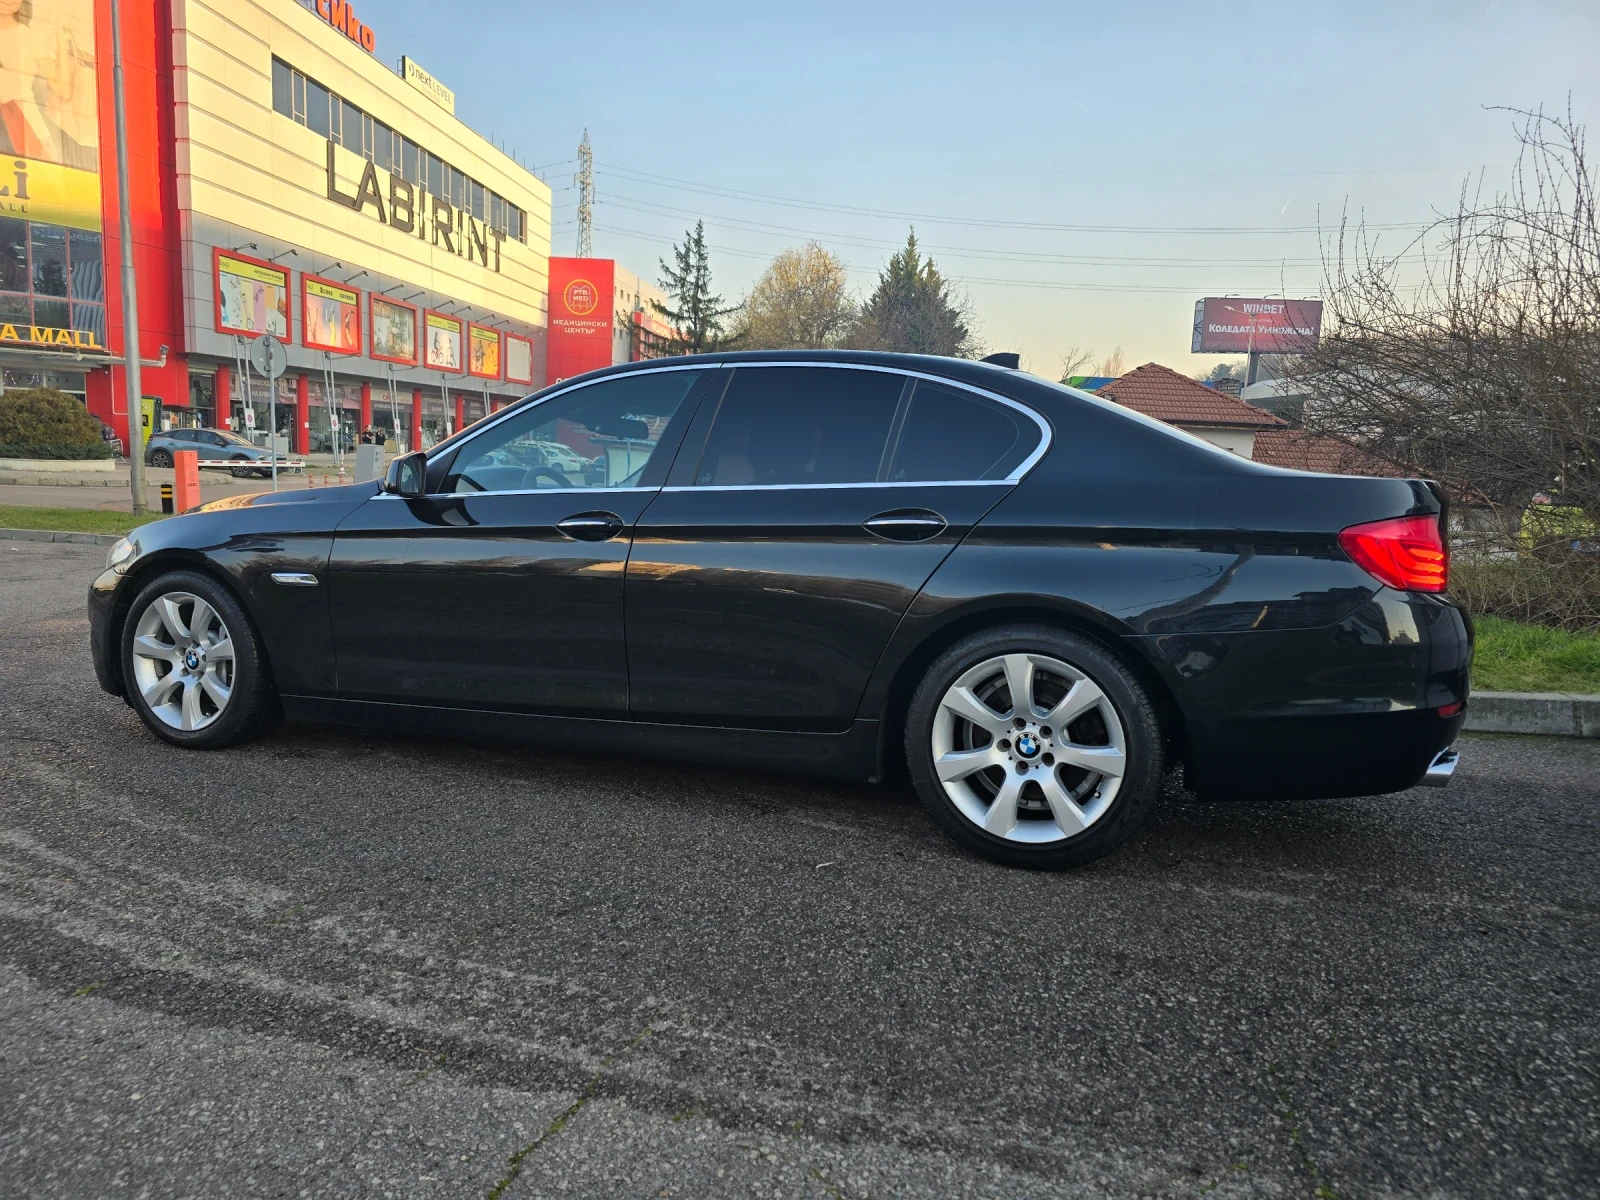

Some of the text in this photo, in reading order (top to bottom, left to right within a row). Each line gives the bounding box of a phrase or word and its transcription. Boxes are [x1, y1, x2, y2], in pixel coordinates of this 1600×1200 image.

[415, 69, 432, 89] next
[433, 81, 451, 104] LEVEL
[326, 140, 507, 273] LABIRINT
[1243, 303, 1285, 314] WINBET
[552, 319, 608, 328] МЕДИЦИНСКИ
[30, 326, 102, 349] MALL
